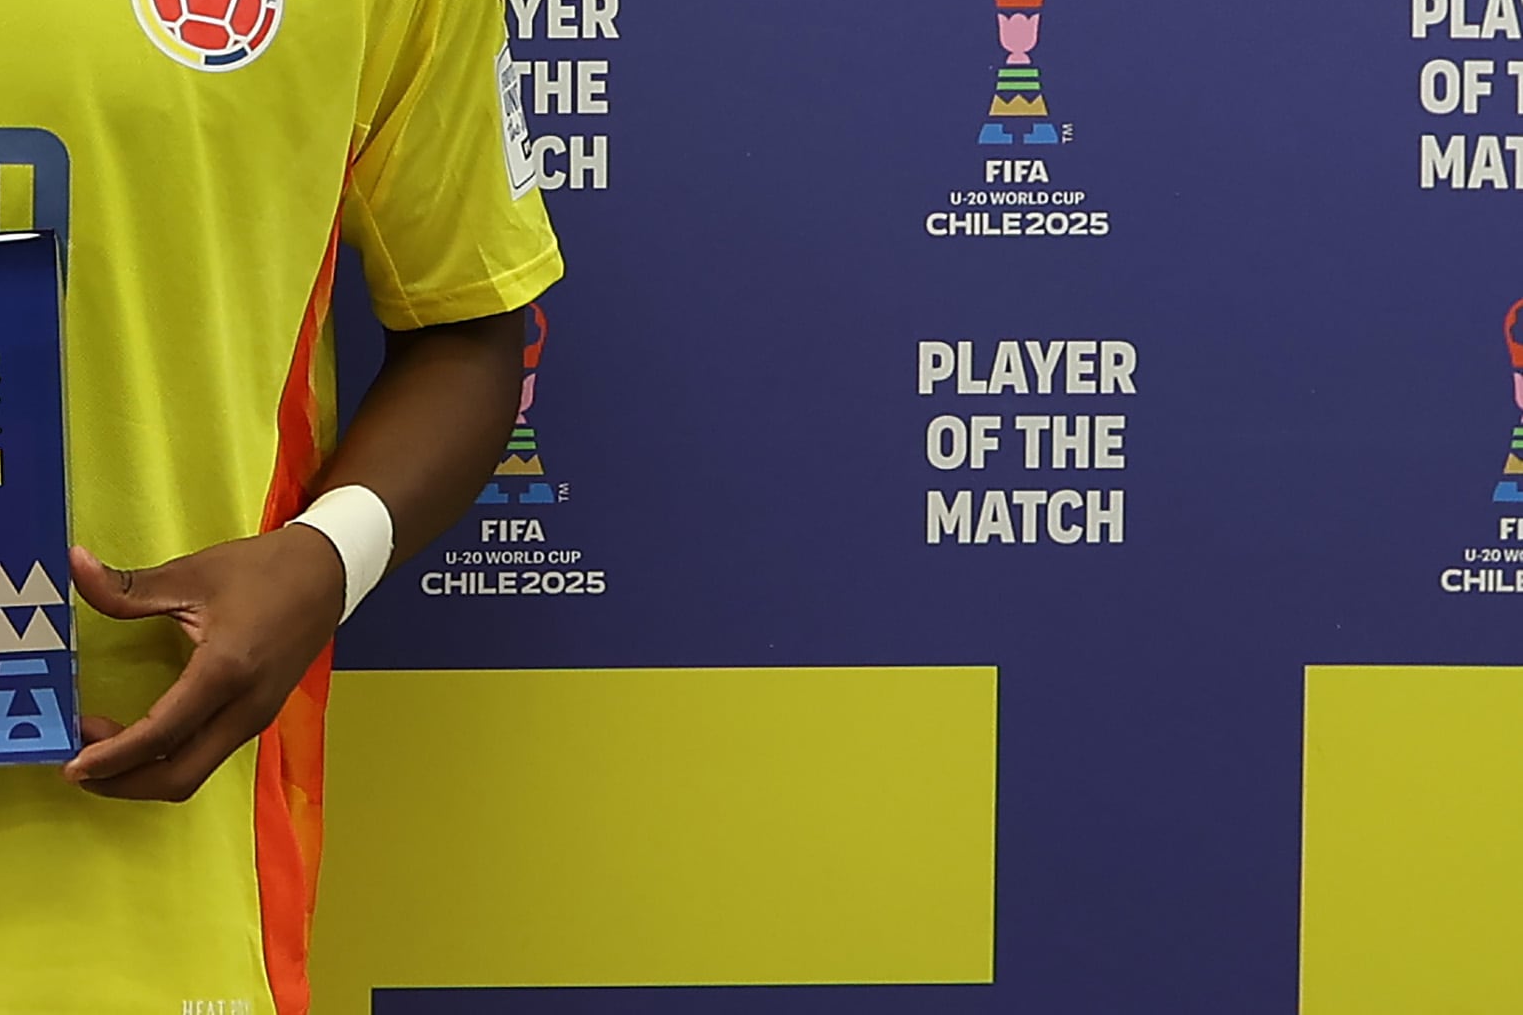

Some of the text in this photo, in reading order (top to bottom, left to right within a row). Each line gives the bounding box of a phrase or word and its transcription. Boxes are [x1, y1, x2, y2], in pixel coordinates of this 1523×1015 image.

[511, 60, 609, 115] HE
[1420, 58, 1495, 115] OF
[985, 159, 1050, 184] FIFA
[1420, 134, 1523, 190] MAT
[950, 191, 1085, 206] U-20 WORLD CUP
[918, 340, 1137, 395] PLAYER
[926, 415, 1126, 470] OF THE
[481, 519, 545, 542] FIFA
[926, 489, 1124, 544] MATCH
[445, 550, 582, 565] U-20 WORLD CUP
